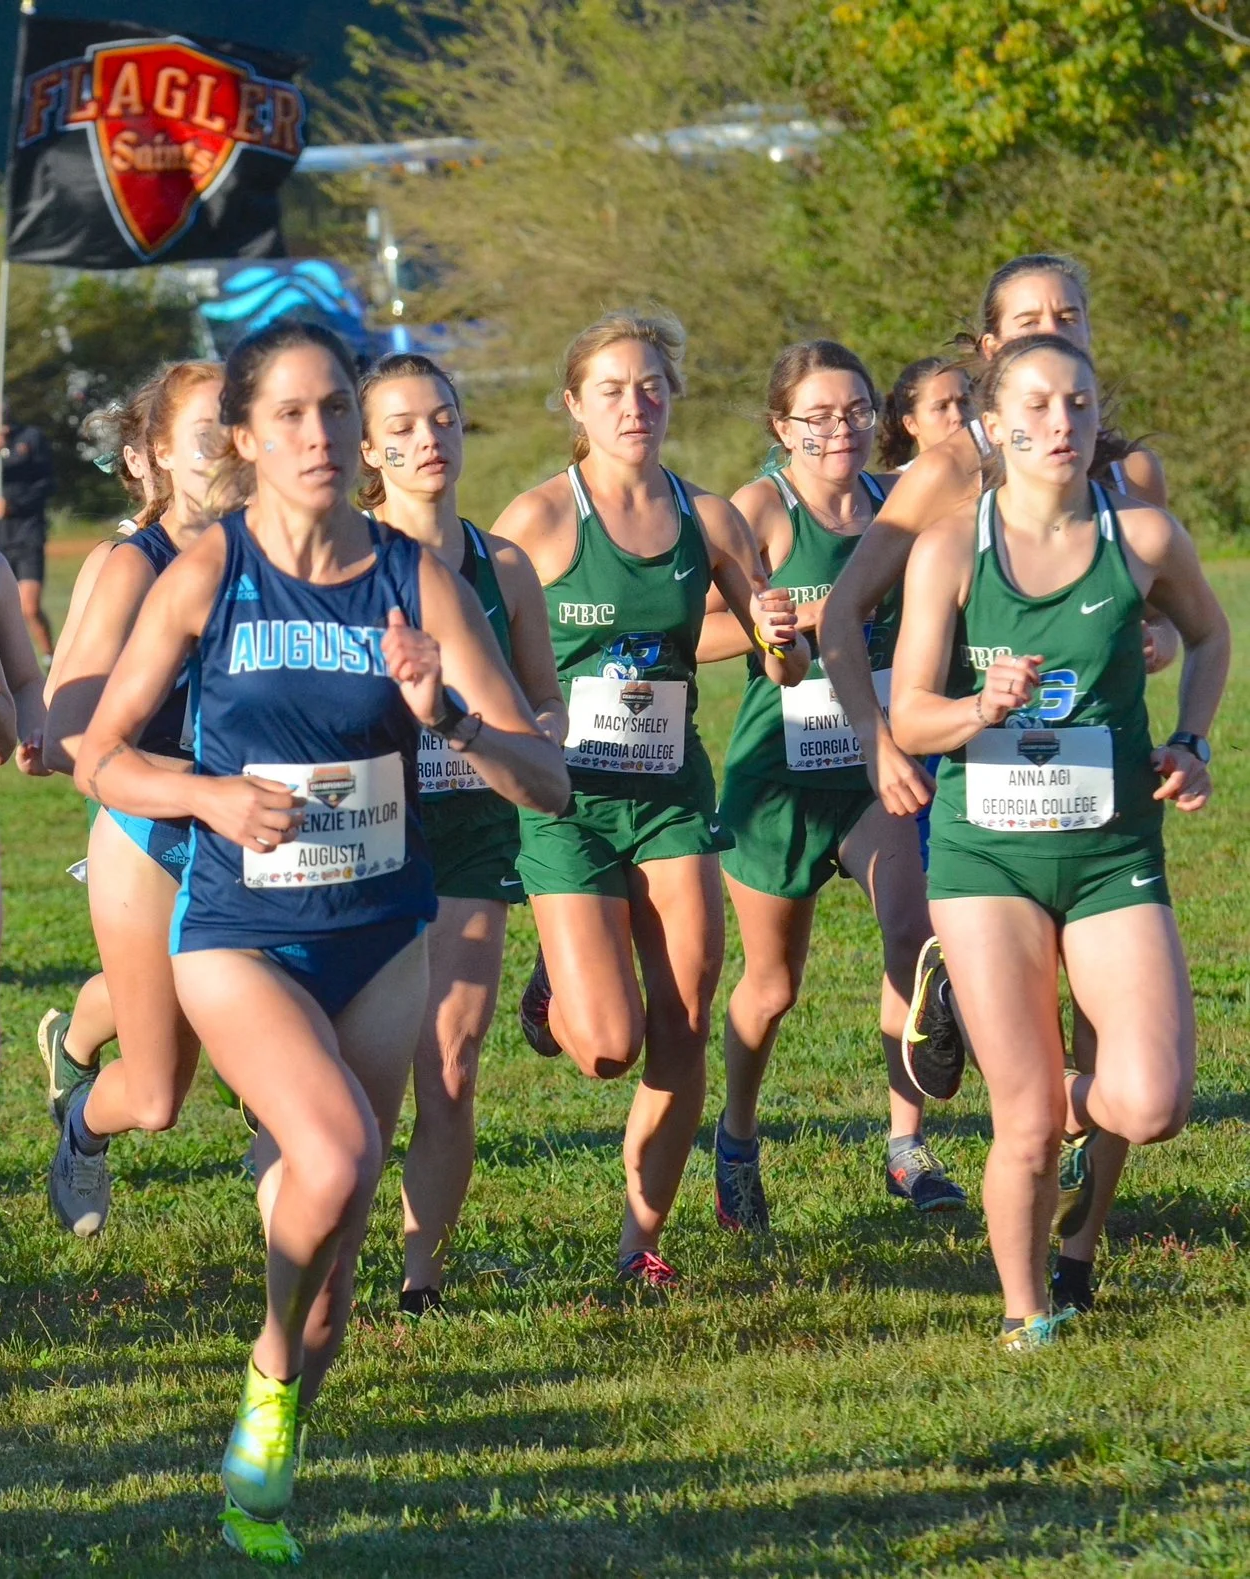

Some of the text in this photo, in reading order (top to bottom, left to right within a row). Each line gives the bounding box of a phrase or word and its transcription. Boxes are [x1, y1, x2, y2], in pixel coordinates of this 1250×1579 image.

[24, 60, 302, 152] FLAGLER
[559, 602, 615, 625] PBC
[229, 620, 388, 676] AUGUST
[594, 714, 668, 734] MACY SHELEY
[803, 714, 840, 731] JENNY
[418, 734, 444, 750] NEY
[579, 739, 675, 760] GEORGIA COLLEGE
[800, 738, 850, 757] GEORGIA
[418, 761, 443, 778] RGIA
[1008, 769, 1071, 786] ANNA AGI
[983, 796, 1098, 815] GEORGIA COLLEGE
[301, 801, 399, 833] ENZIE TAYLOR
[298, 842, 366, 867] AUGUSTA
